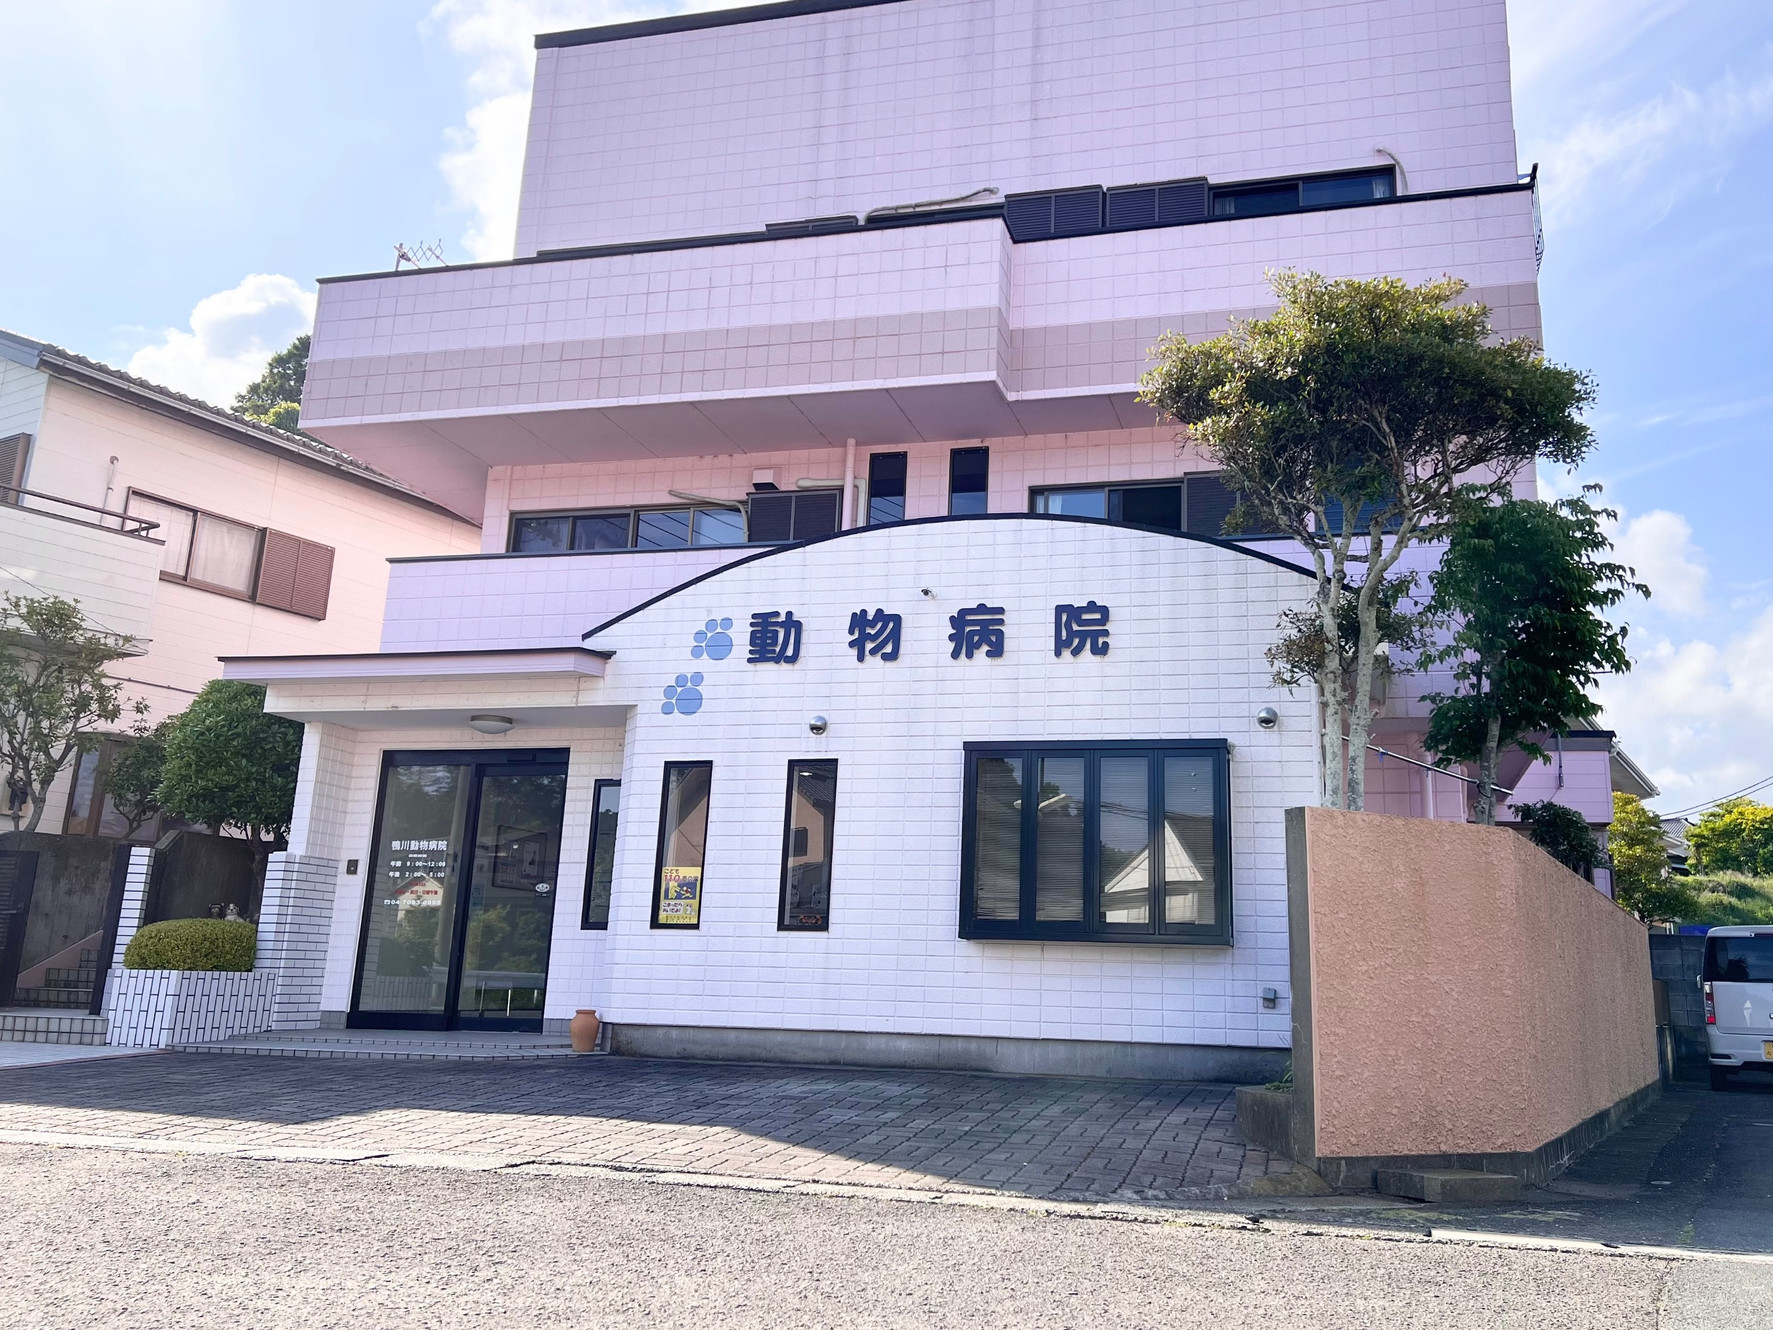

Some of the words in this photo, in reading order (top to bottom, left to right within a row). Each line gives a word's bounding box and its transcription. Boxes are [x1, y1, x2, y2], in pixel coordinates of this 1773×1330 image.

[746, 600, 1110, 664] 動物病院
[391, 840, 448, 851] 鴨川動物病院
